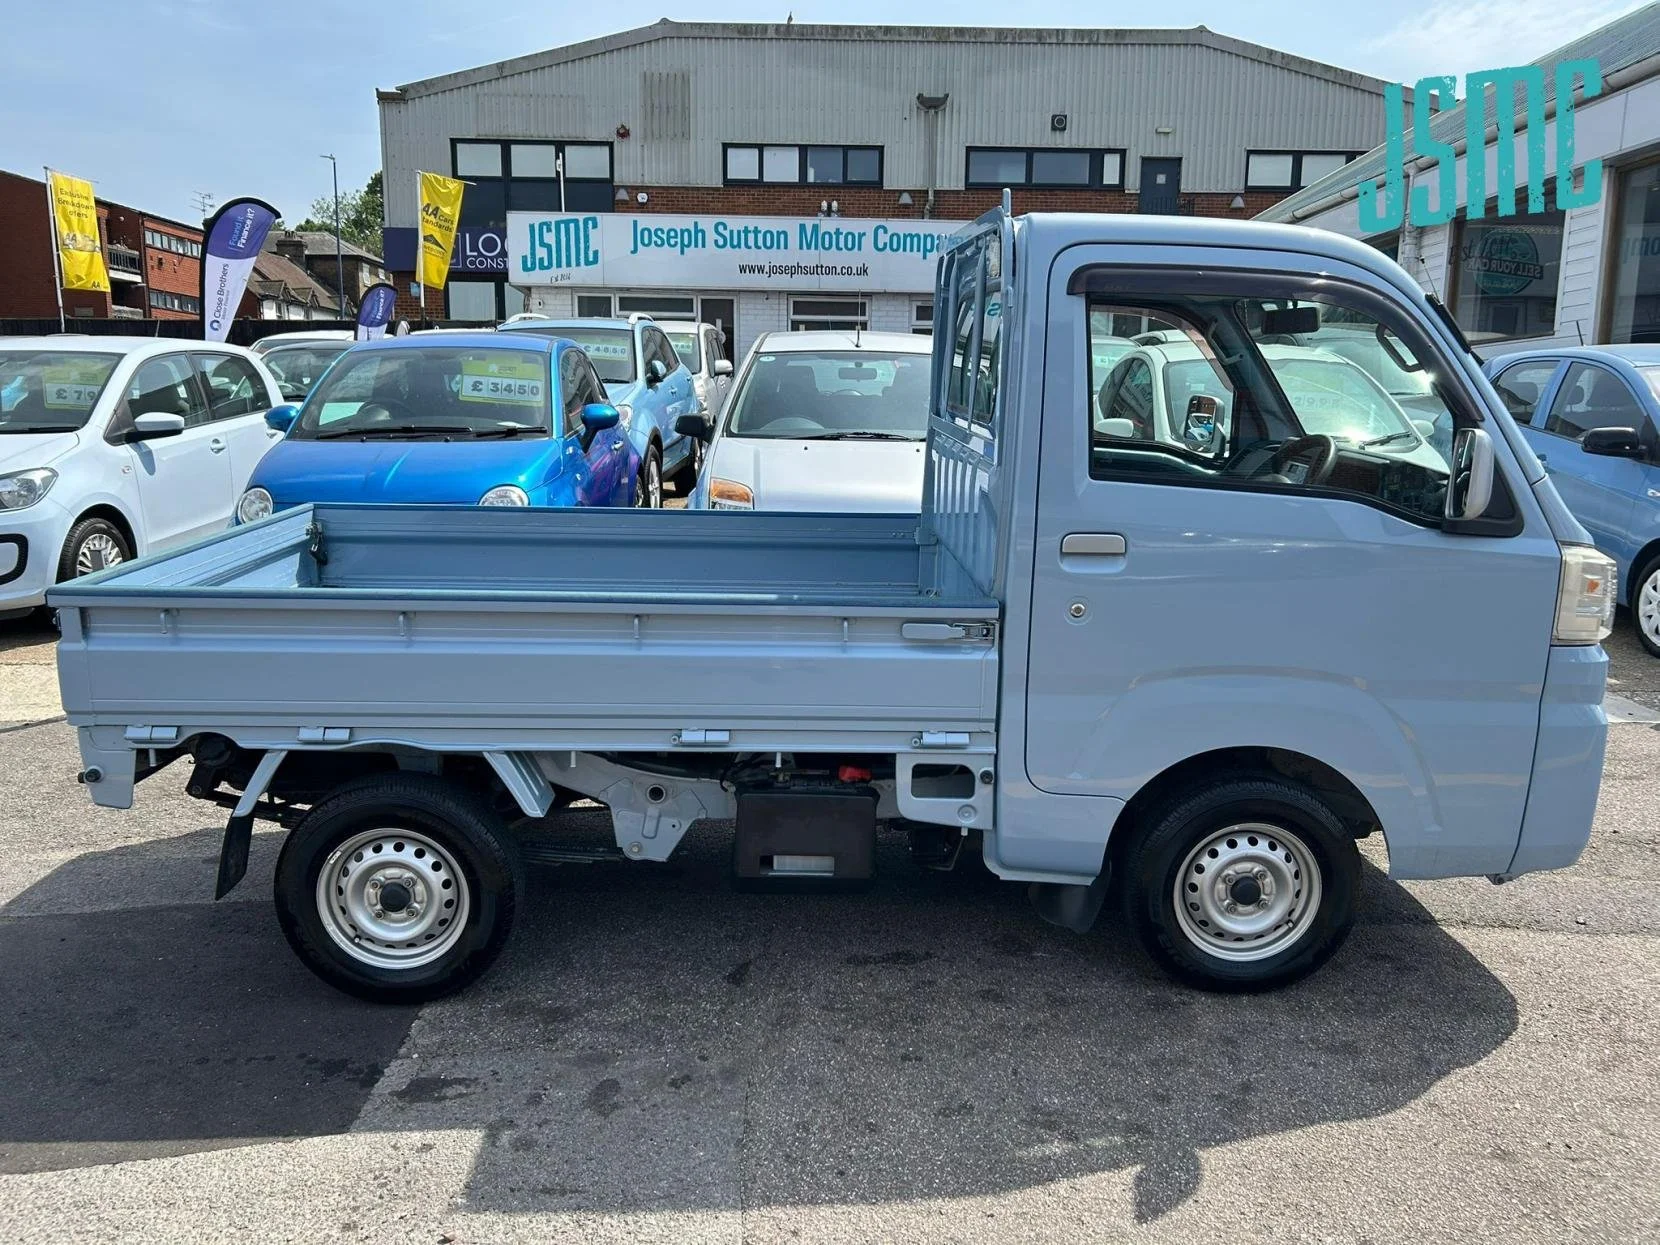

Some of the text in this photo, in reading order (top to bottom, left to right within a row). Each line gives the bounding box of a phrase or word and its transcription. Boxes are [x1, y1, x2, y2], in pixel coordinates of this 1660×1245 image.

[57, 197, 95, 210] Breakdown
[422, 203, 440, 219] AA
[238, 218, 252, 248] Finance
[422, 216, 453, 233] tandards
[465, 233, 508, 257] LO
[521, 216, 599, 272] JSMC
[630, 219, 706, 259] Joseph
[713, 221, 789, 251] Sutton
[799, 223, 865, 252] Motor
[738, 262, 869, 279] www.josephsutton.co.uk
[213, 263, 230, 319] Close Brothers
